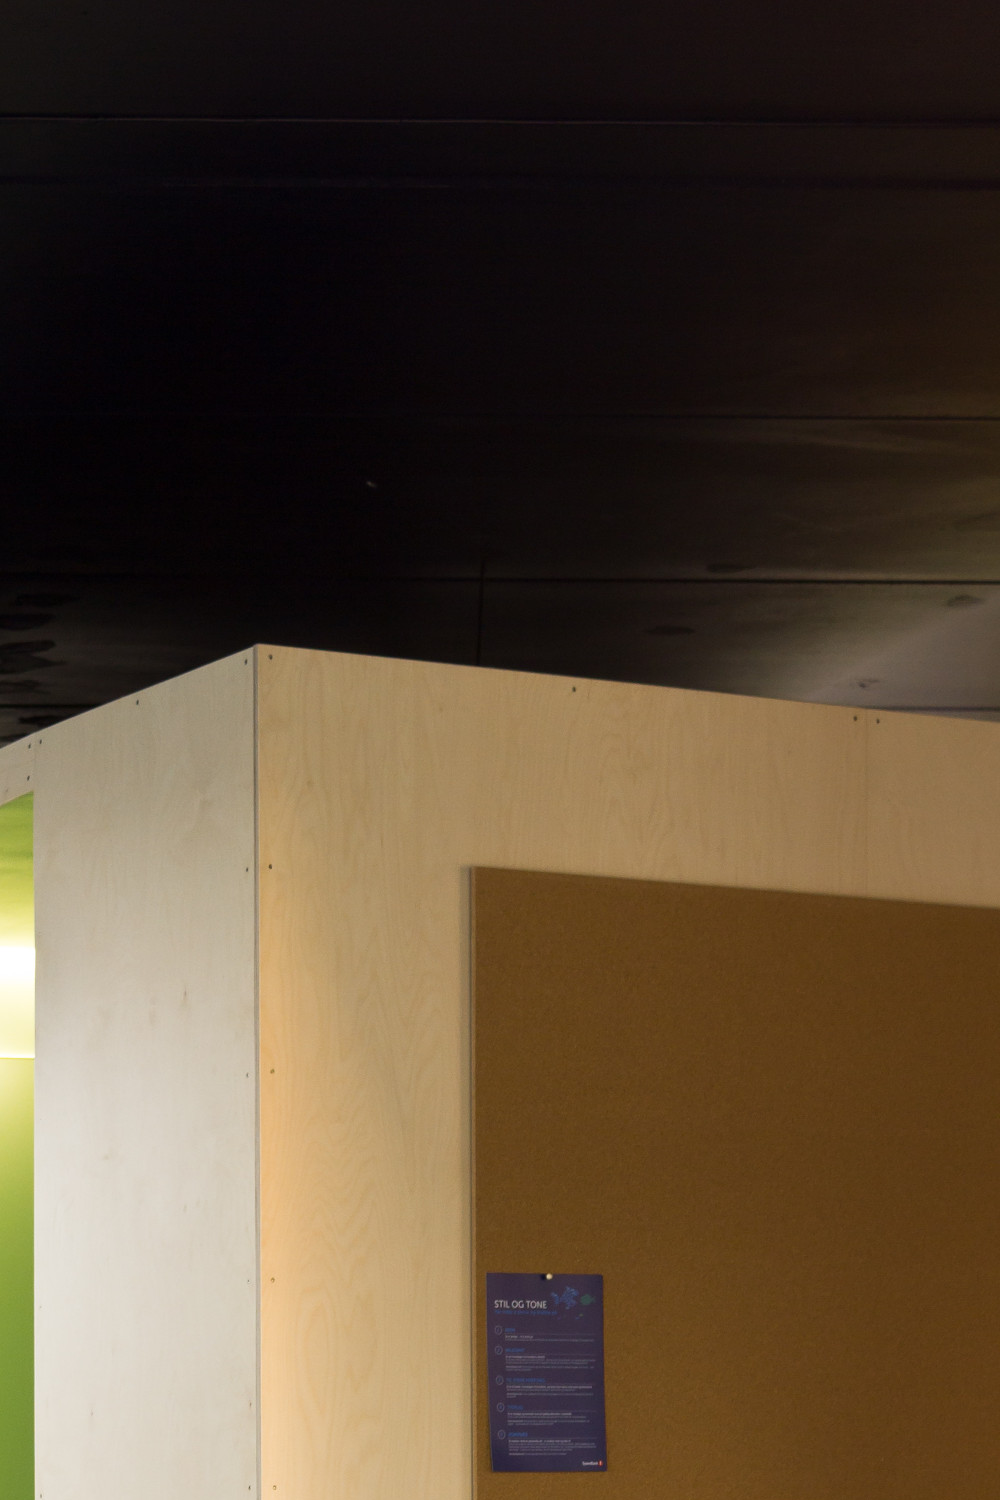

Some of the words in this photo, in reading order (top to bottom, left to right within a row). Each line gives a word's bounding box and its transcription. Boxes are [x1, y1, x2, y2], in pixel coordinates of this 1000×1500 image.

[494, 1299, 510, 1309] STIL
[511, 1299, 525, 1309] OG
[526, 1300, 548, 1309] TONE
